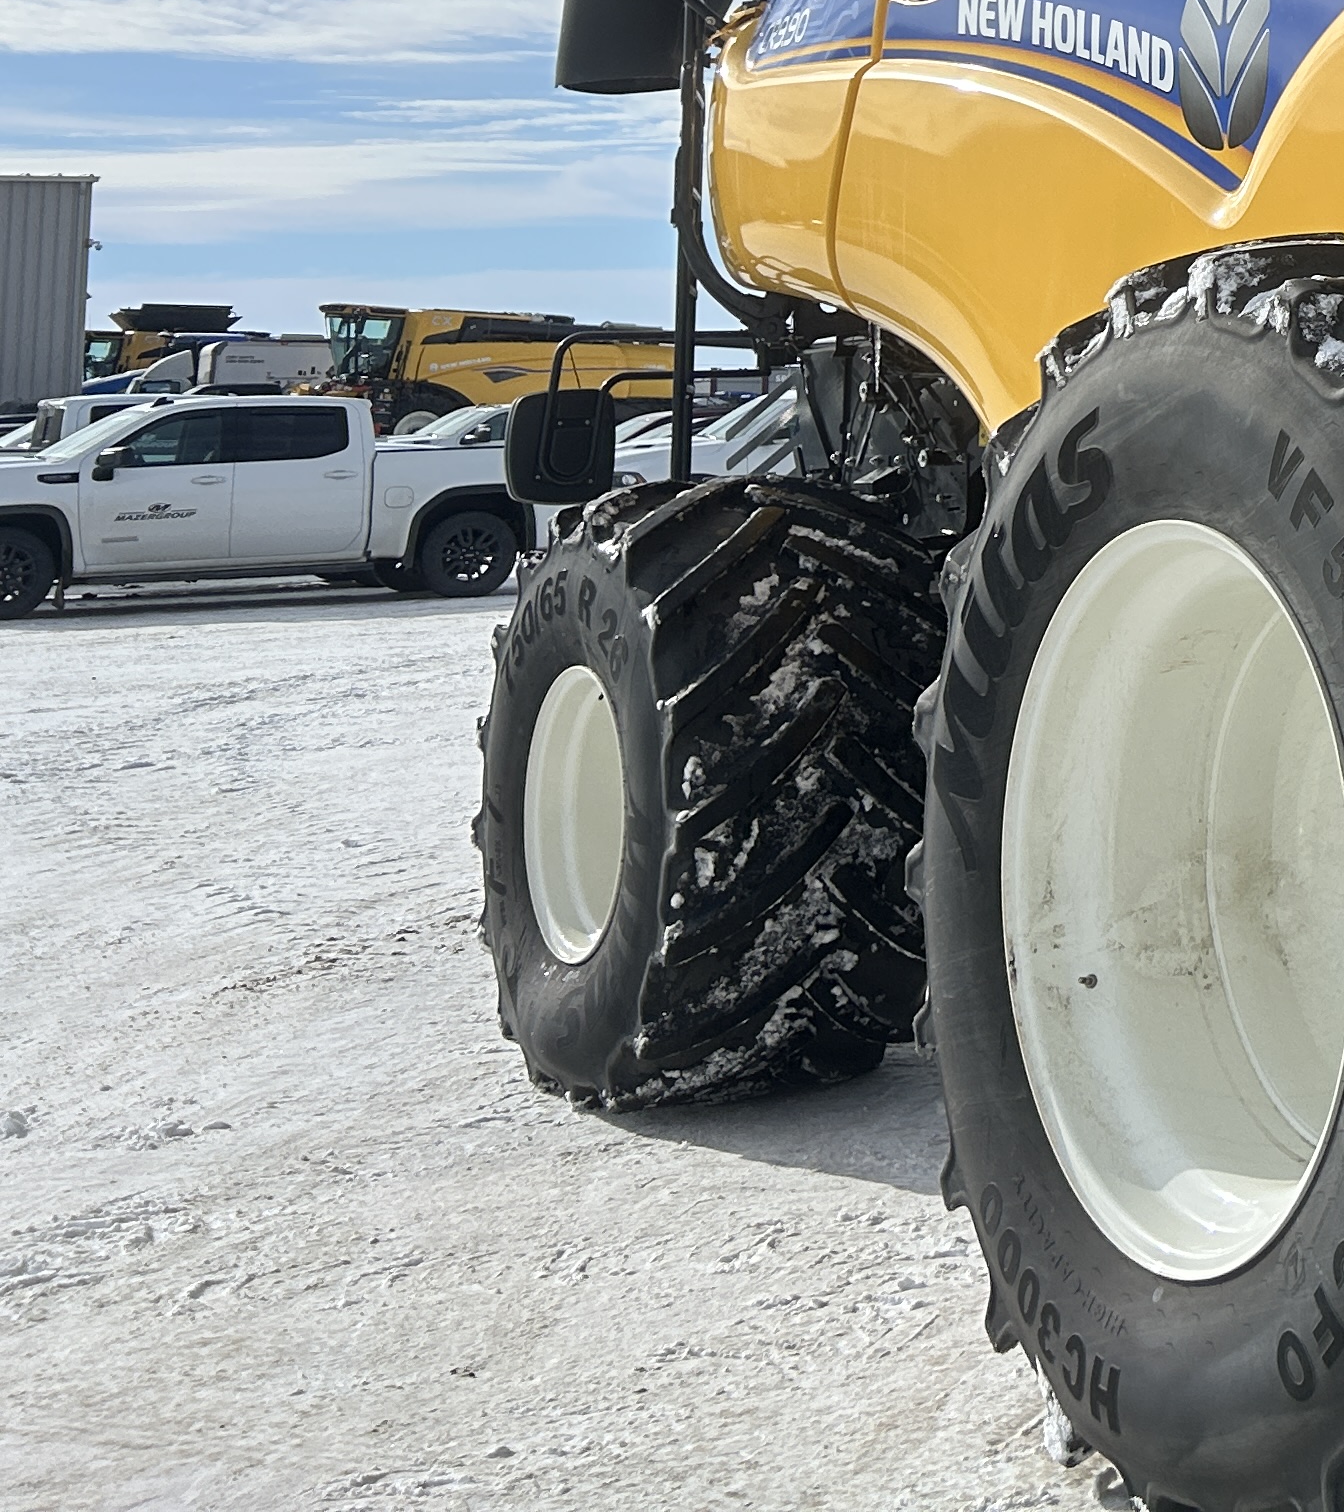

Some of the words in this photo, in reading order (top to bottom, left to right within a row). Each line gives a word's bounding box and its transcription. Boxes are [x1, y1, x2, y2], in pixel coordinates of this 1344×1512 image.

[114, 512, 197, 522] MAZERGROUP
[1267, 428, 1335, 532] VF
[578, 575, 597, 629] R
[933, 406, 1113, 872] Mitas
[980, 1182, 1121, 1436] HC3000
